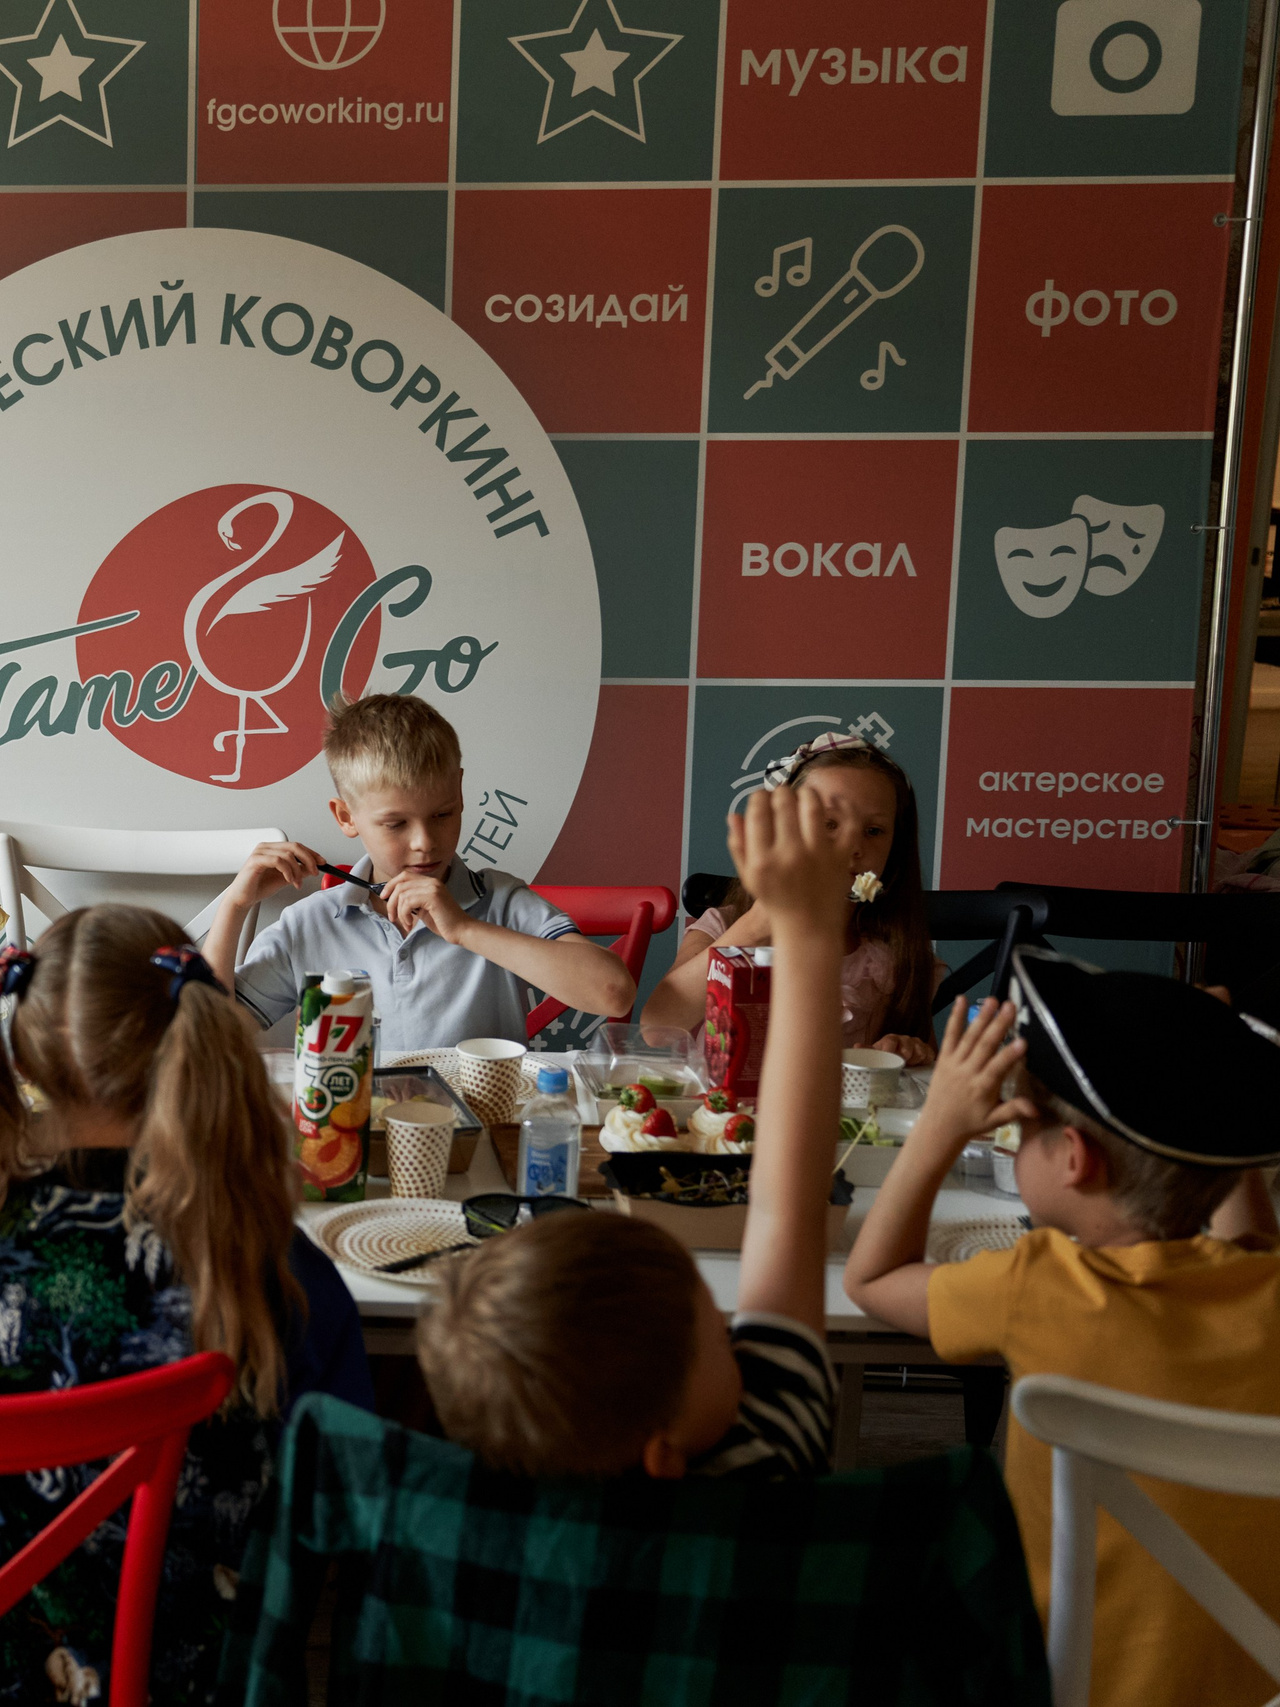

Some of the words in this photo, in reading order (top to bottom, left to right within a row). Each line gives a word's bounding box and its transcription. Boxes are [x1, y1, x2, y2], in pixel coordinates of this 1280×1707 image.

[739, 45, 968, 97] музыка
[206, 97, 445, 131] fgcoworking.ru
[484, 284, 689, 328] созидай
[1025, 279, 1178, 337] фото
[220, 292, 550, 541] КОВОРКИНГ
[740, 541, 918, 578] вокал
[321, 564, 500, 704] Go
[978, 770, 1165, 798] актерское
[460, 789, 528, 865] ТЕЙ
[965, 815, 1173, 845] мастерство
[307, 1015, 365, 1054] J7
